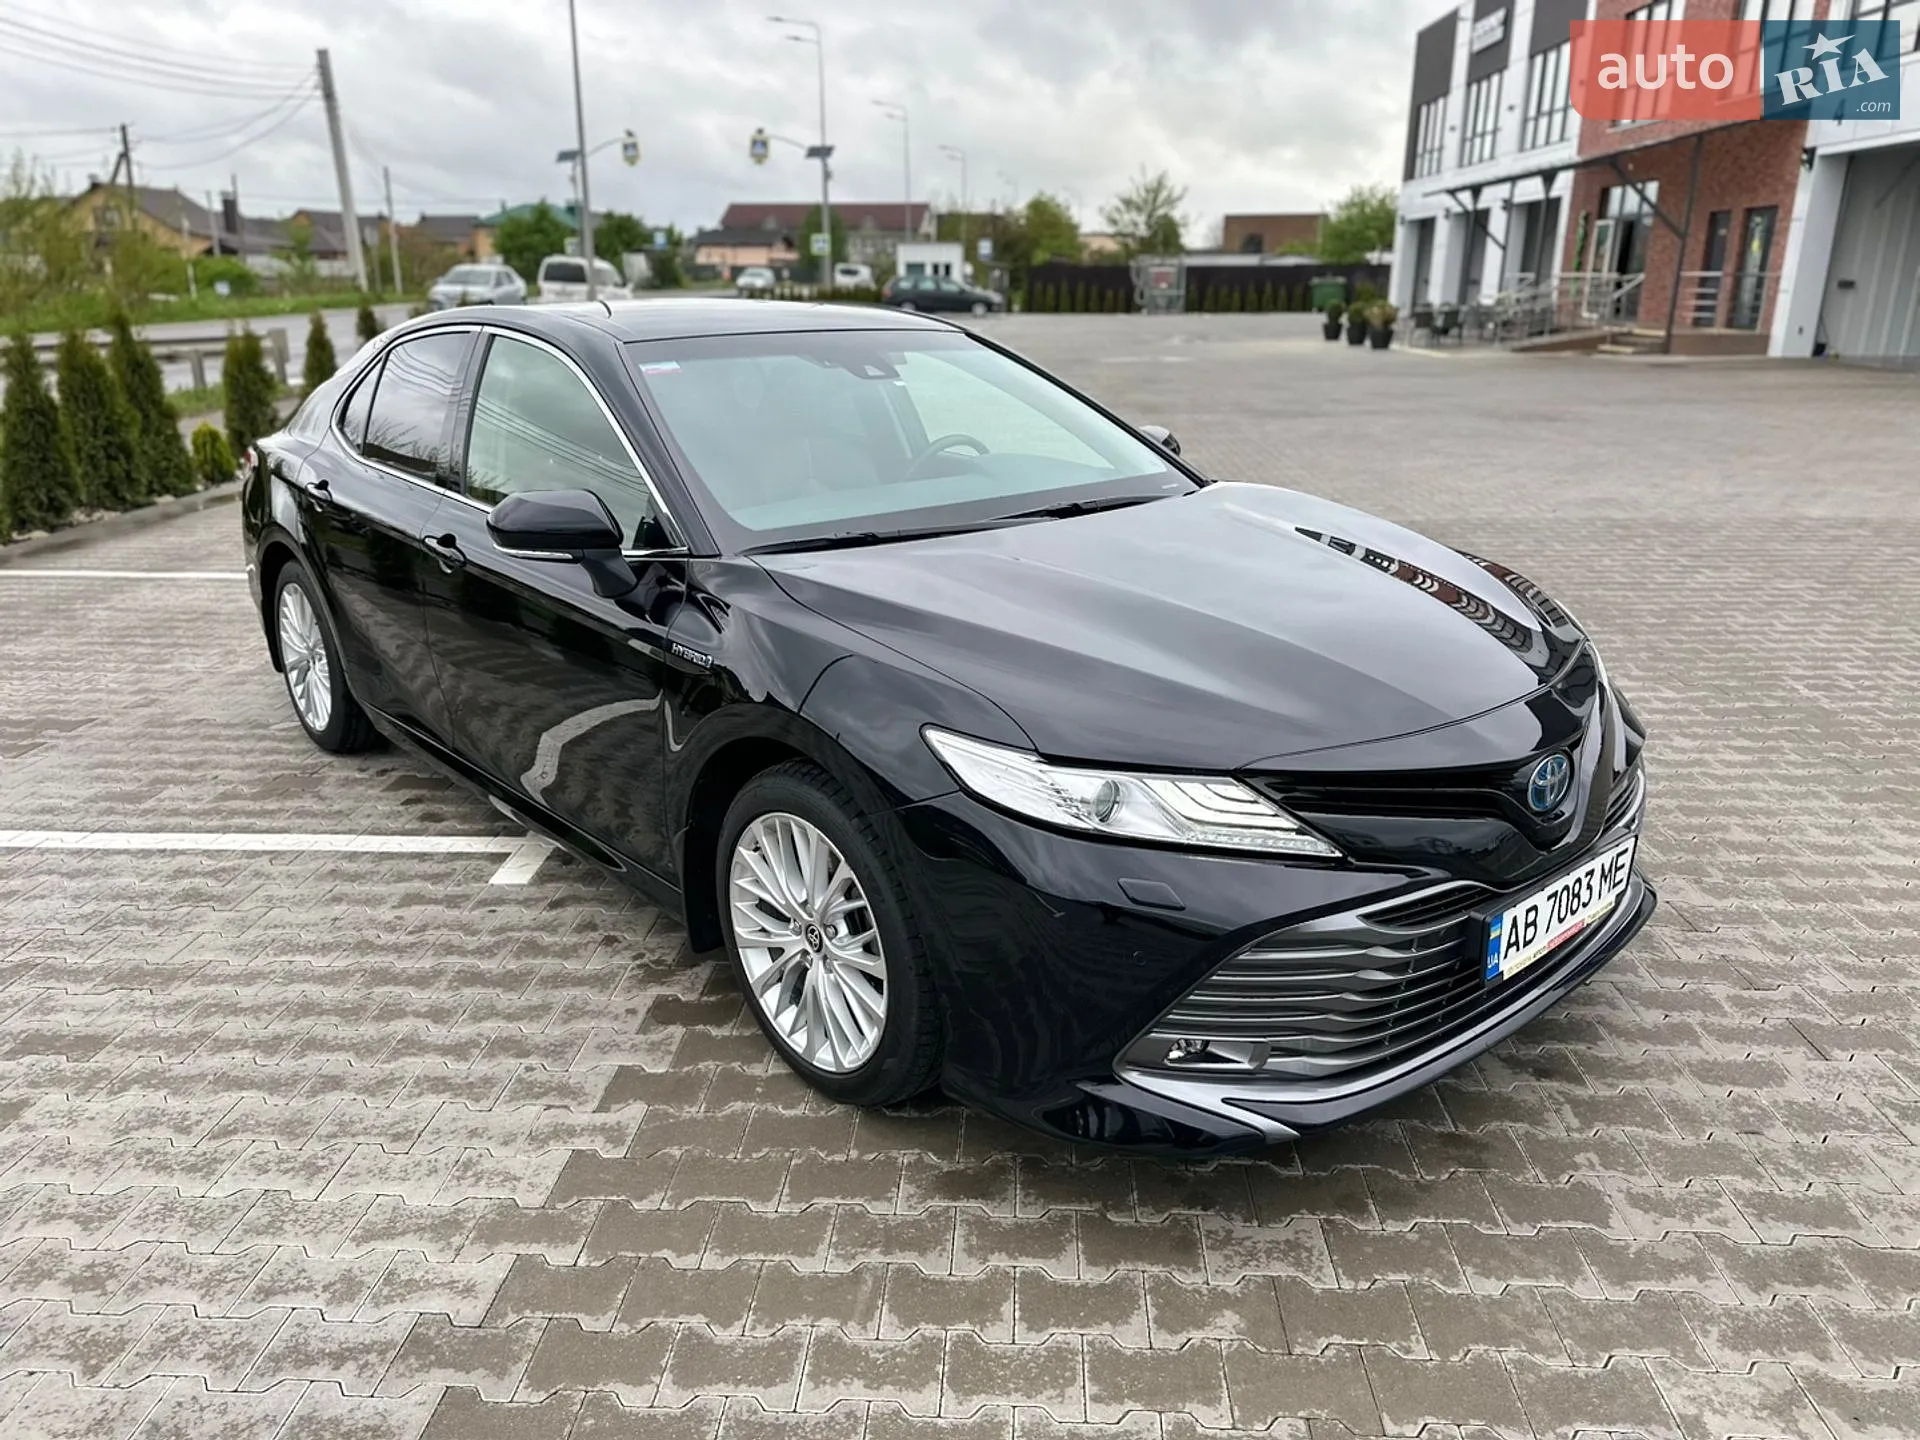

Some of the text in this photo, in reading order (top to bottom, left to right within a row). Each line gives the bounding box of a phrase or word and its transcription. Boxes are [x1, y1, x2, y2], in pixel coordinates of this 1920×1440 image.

[671, 642, 707, 667] HYBRID
[1503, 904, 1539, 960] AB
[1546, 868, 1596, 935] 7083
[1599, 847, 1629, 901] ME
[1487, 952, 1499, 968] UA
